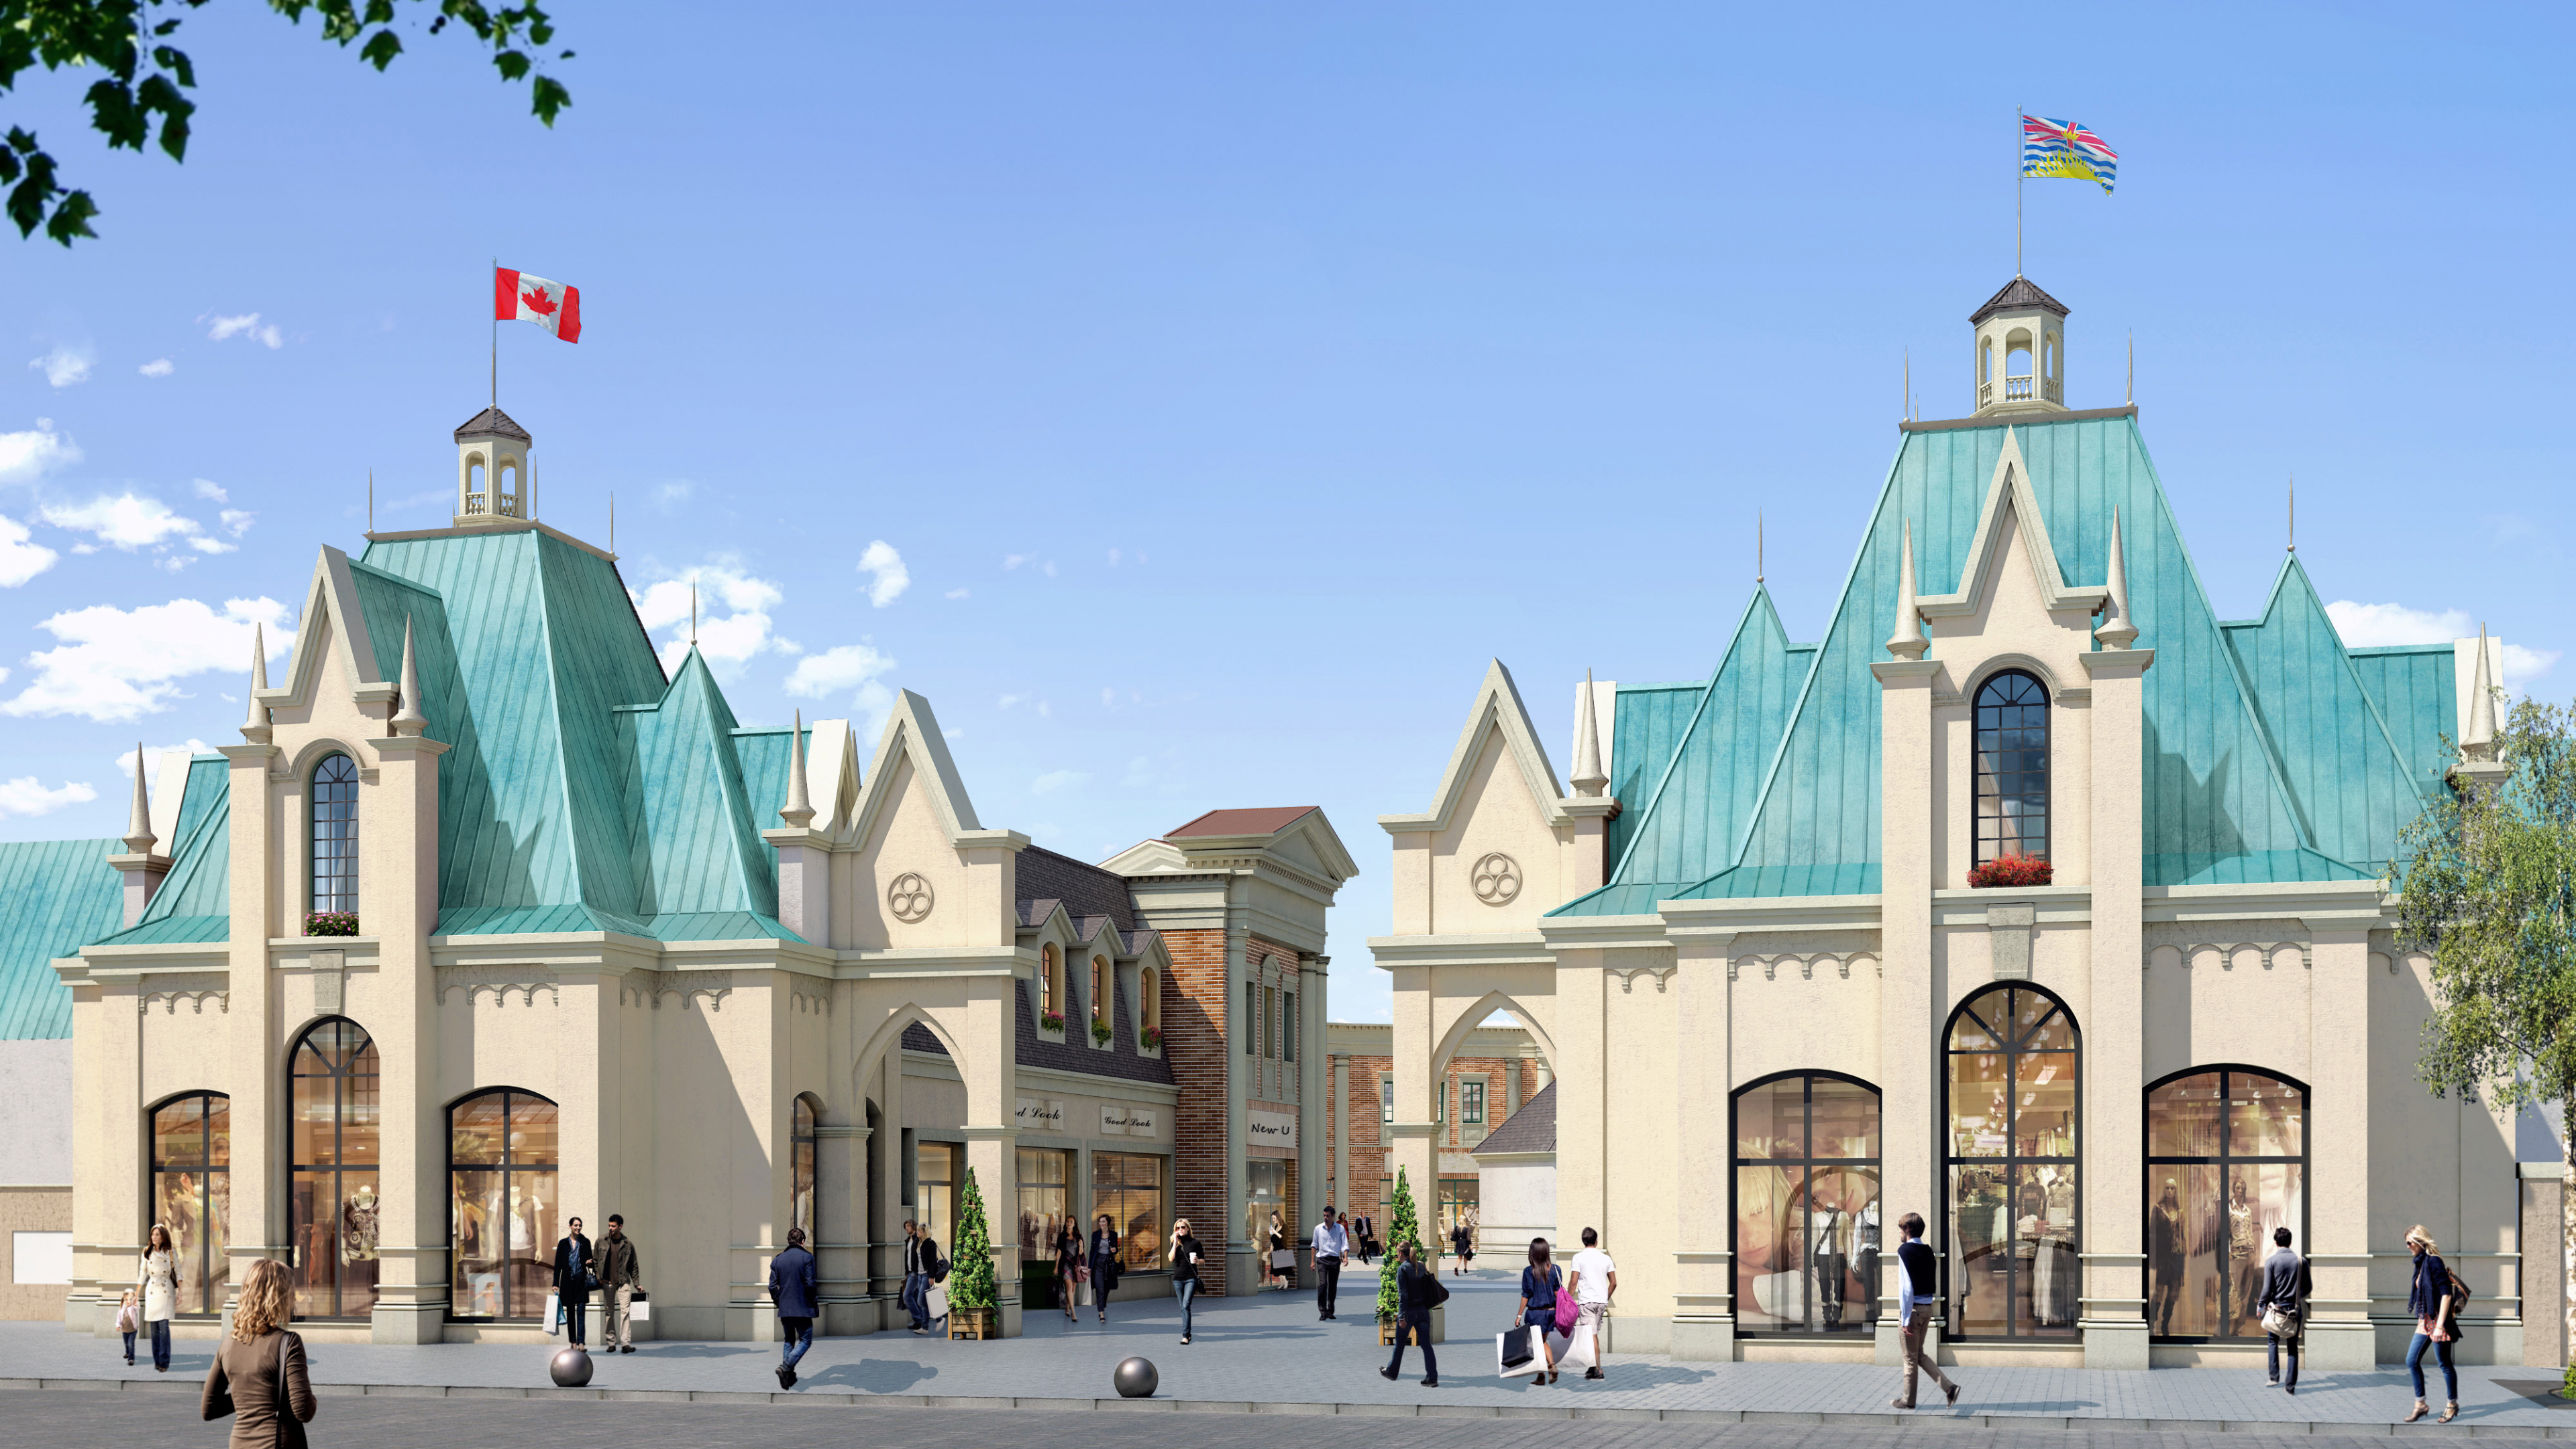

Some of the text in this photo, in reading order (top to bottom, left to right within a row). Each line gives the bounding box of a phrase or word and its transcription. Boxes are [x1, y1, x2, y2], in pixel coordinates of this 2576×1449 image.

[1030, 1107, 1061, 1120] Look
[1104, 1116, 1152, 1127] Good Look
[1251, 1123, 1289, 1135] New U
